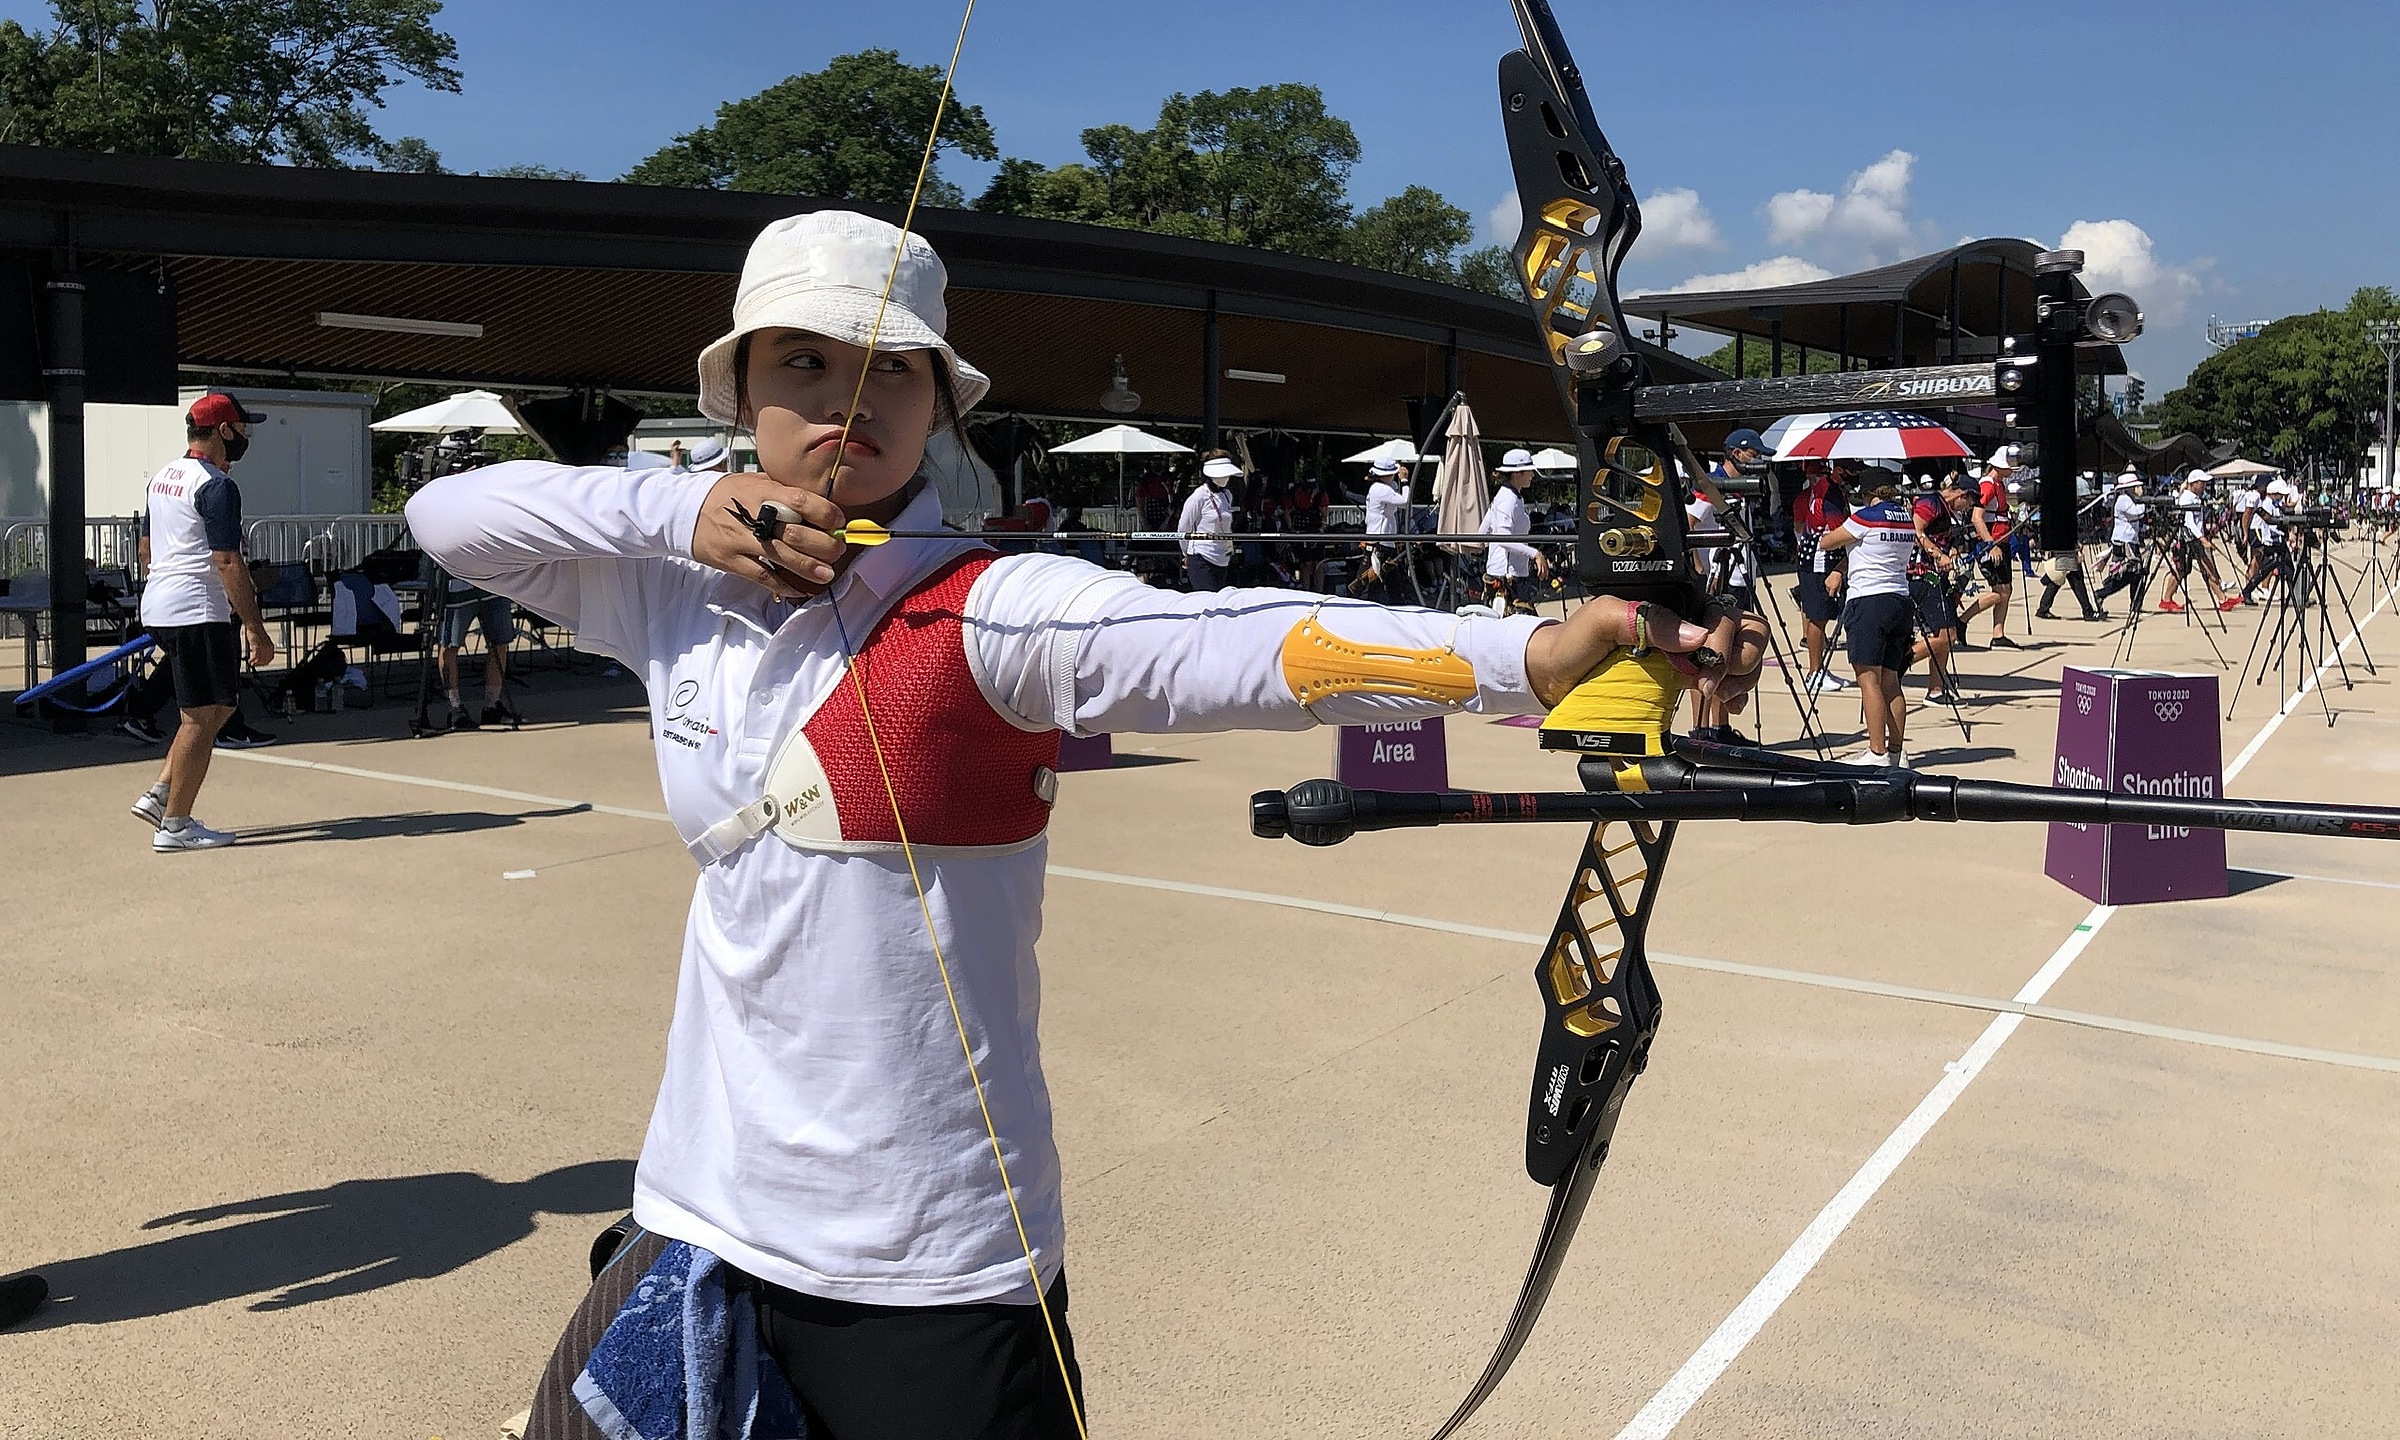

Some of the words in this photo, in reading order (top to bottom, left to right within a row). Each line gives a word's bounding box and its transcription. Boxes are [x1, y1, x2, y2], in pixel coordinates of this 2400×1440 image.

[1897, 374, 1992, 397] SHIBUYA
[1612, 560, 1674, 571] WIAWIS
[2075, 682, 2086, 693] TOKYO
[2147, 690, 2172, 700] TOKYO
[2172, 689, 2190, 700] 2020
[1371, 739, 1415, 763] Area
[2057, 755, 2103, 791] Shooting
[2122, 771, 2213, 799] Shooting
[784, 784, 821, 818] W&W
[2214, 810, 2344, 833] WIAWIS
[2349, 821, 2400, 834] ACS-
[1549, 1064, 1570, 1117] WIAWIS
